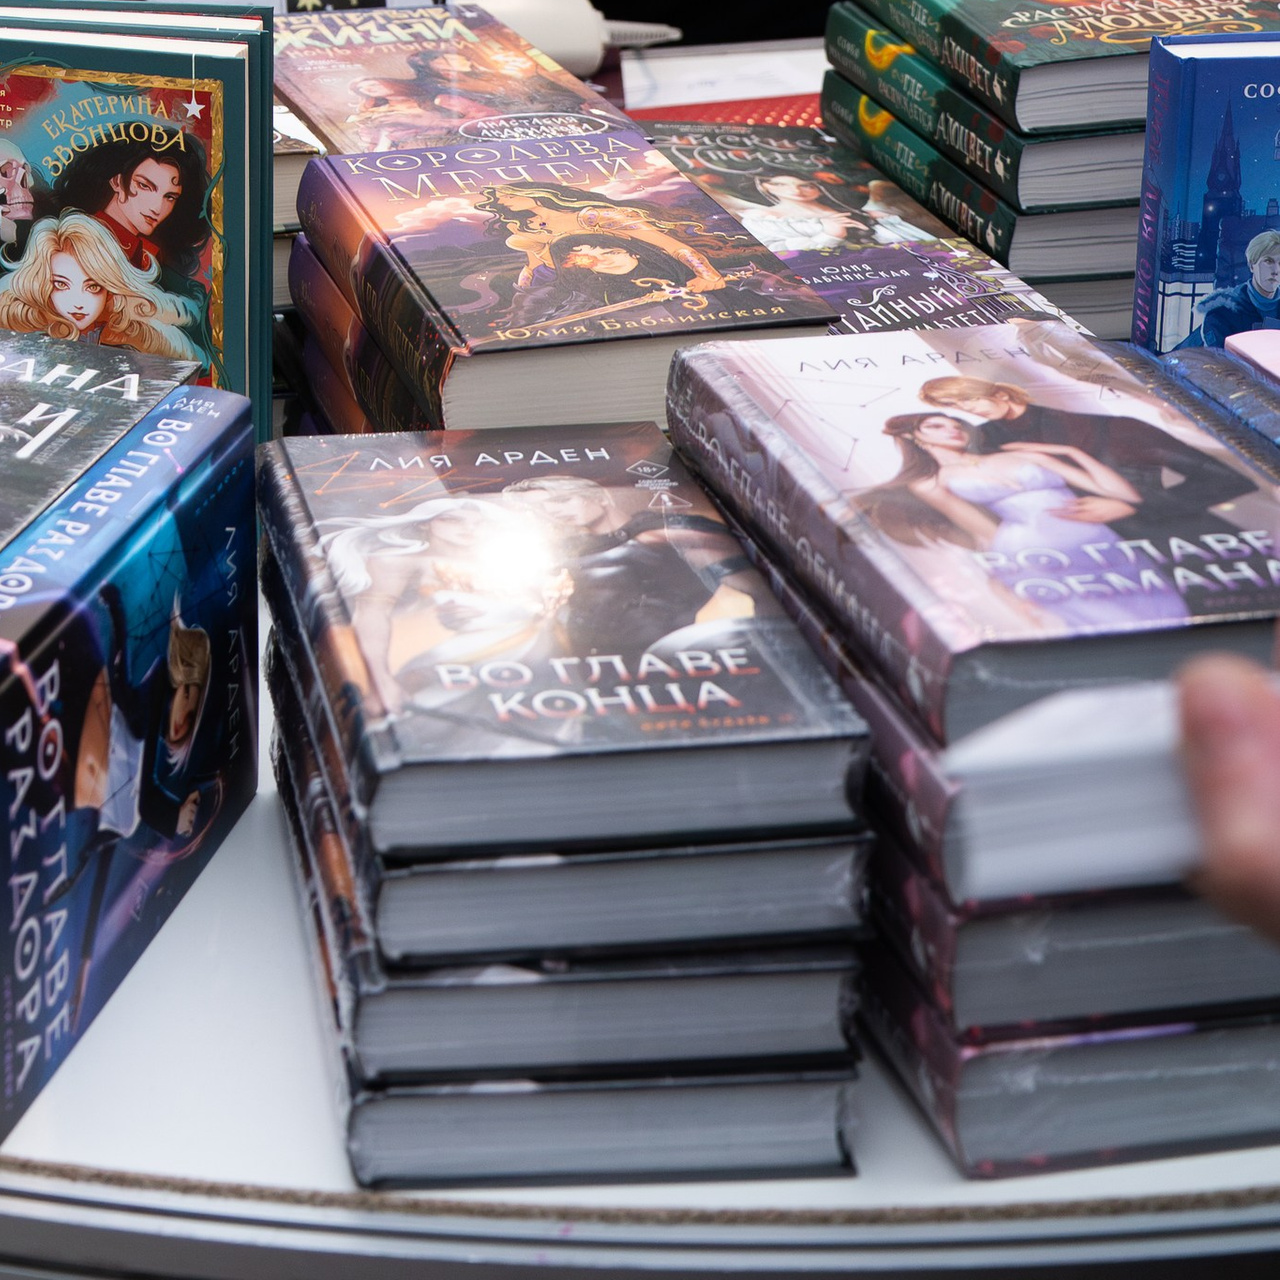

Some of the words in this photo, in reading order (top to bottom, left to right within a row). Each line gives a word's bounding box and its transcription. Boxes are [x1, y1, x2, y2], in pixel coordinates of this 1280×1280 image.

[41, 95, 170, 140] ЕКАТЕРИНА
[41, 122, 187, 177] ЗВОНЦОВА
[342, 135, 641, 176] КОРОЛЕВА
[372, 154, 645, 203] МЕЧЕЙ
[496, 321, 588, 341] Юлия
[598, 306, 786, 333] Бабчинская
[800, 357, 878, 372] ЛИЯ
[902, 347, 1031, 366] АРДЕН
[159, 404, 220, 418] АРДЕН
[175, 397, 215, 408] ЛИЯ
[16, 403, 81, 459] И
[143, 418, 193, 447] ВО
[370, 454, 452, 470] ЛИЯ
[475, 447, 610, 466] АРДЕН
[72, 450, 160, 519] ГЛАВЕ
[436, 661, 532, 690] ВО
[549, 648, 760, 685] ГЛАВЕ
[489, 680, 743, 723] КОНЦА
